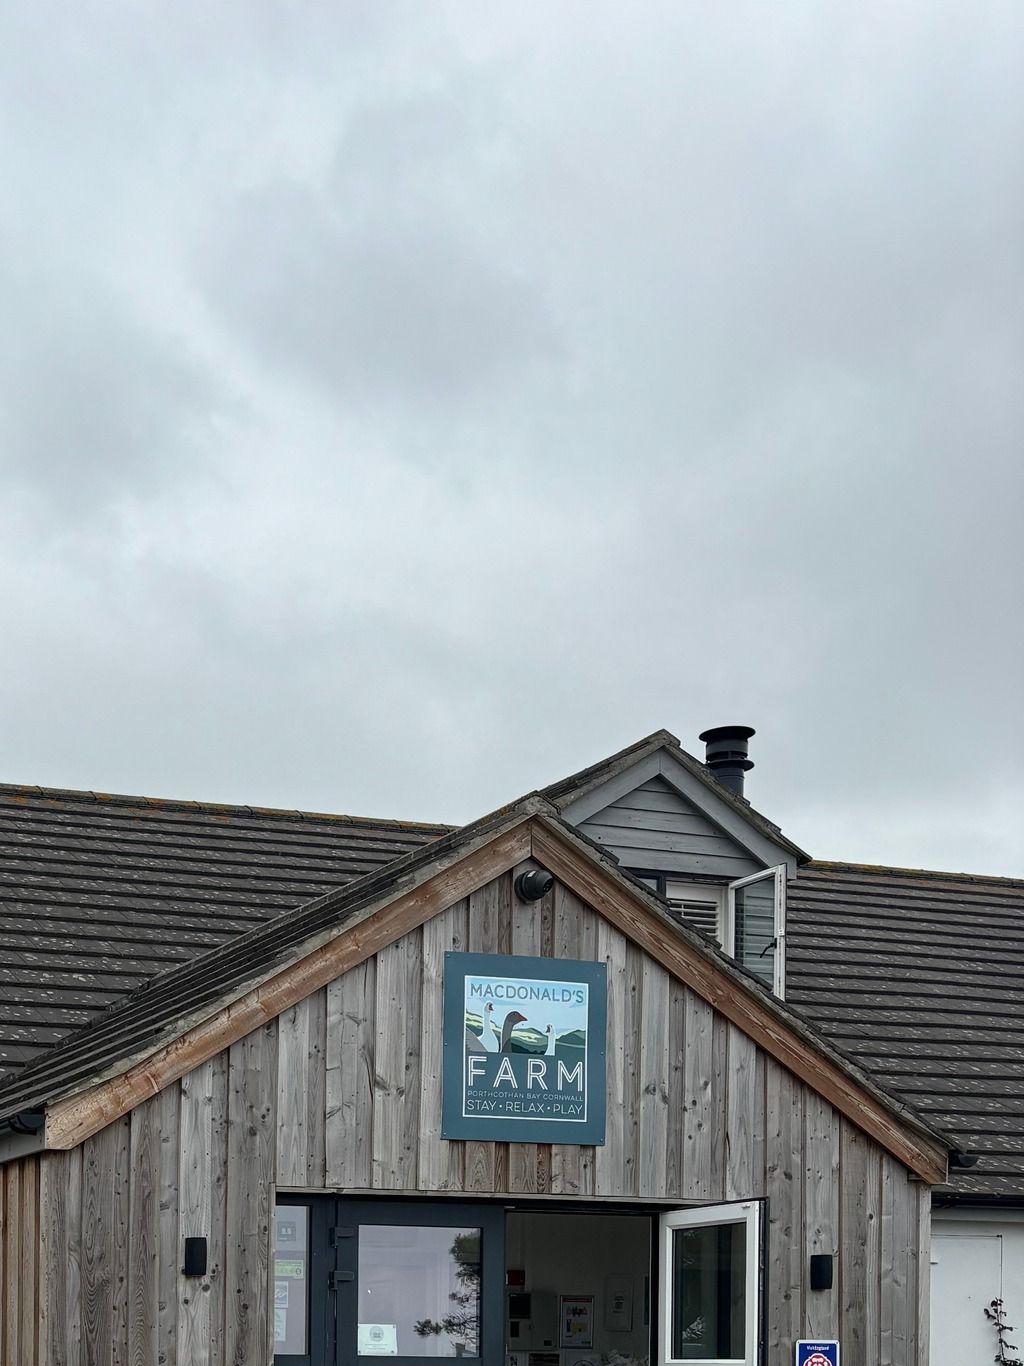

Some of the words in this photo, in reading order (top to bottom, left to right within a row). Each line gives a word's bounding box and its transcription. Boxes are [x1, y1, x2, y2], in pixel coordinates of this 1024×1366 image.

[470, 983, 584, 1004] MACDONALD'S
[468, 1056, 583, 1092] FARM
[467, 1090, 524, 1099] PORTHCOTHAN
[542, 1093, 583, 1102] CORNWALL
[467, 1099, 497, 1111] STAY
[506, 1102, 545, 1113] RELAX
[553, 1103, 583, 1115] PLAY
